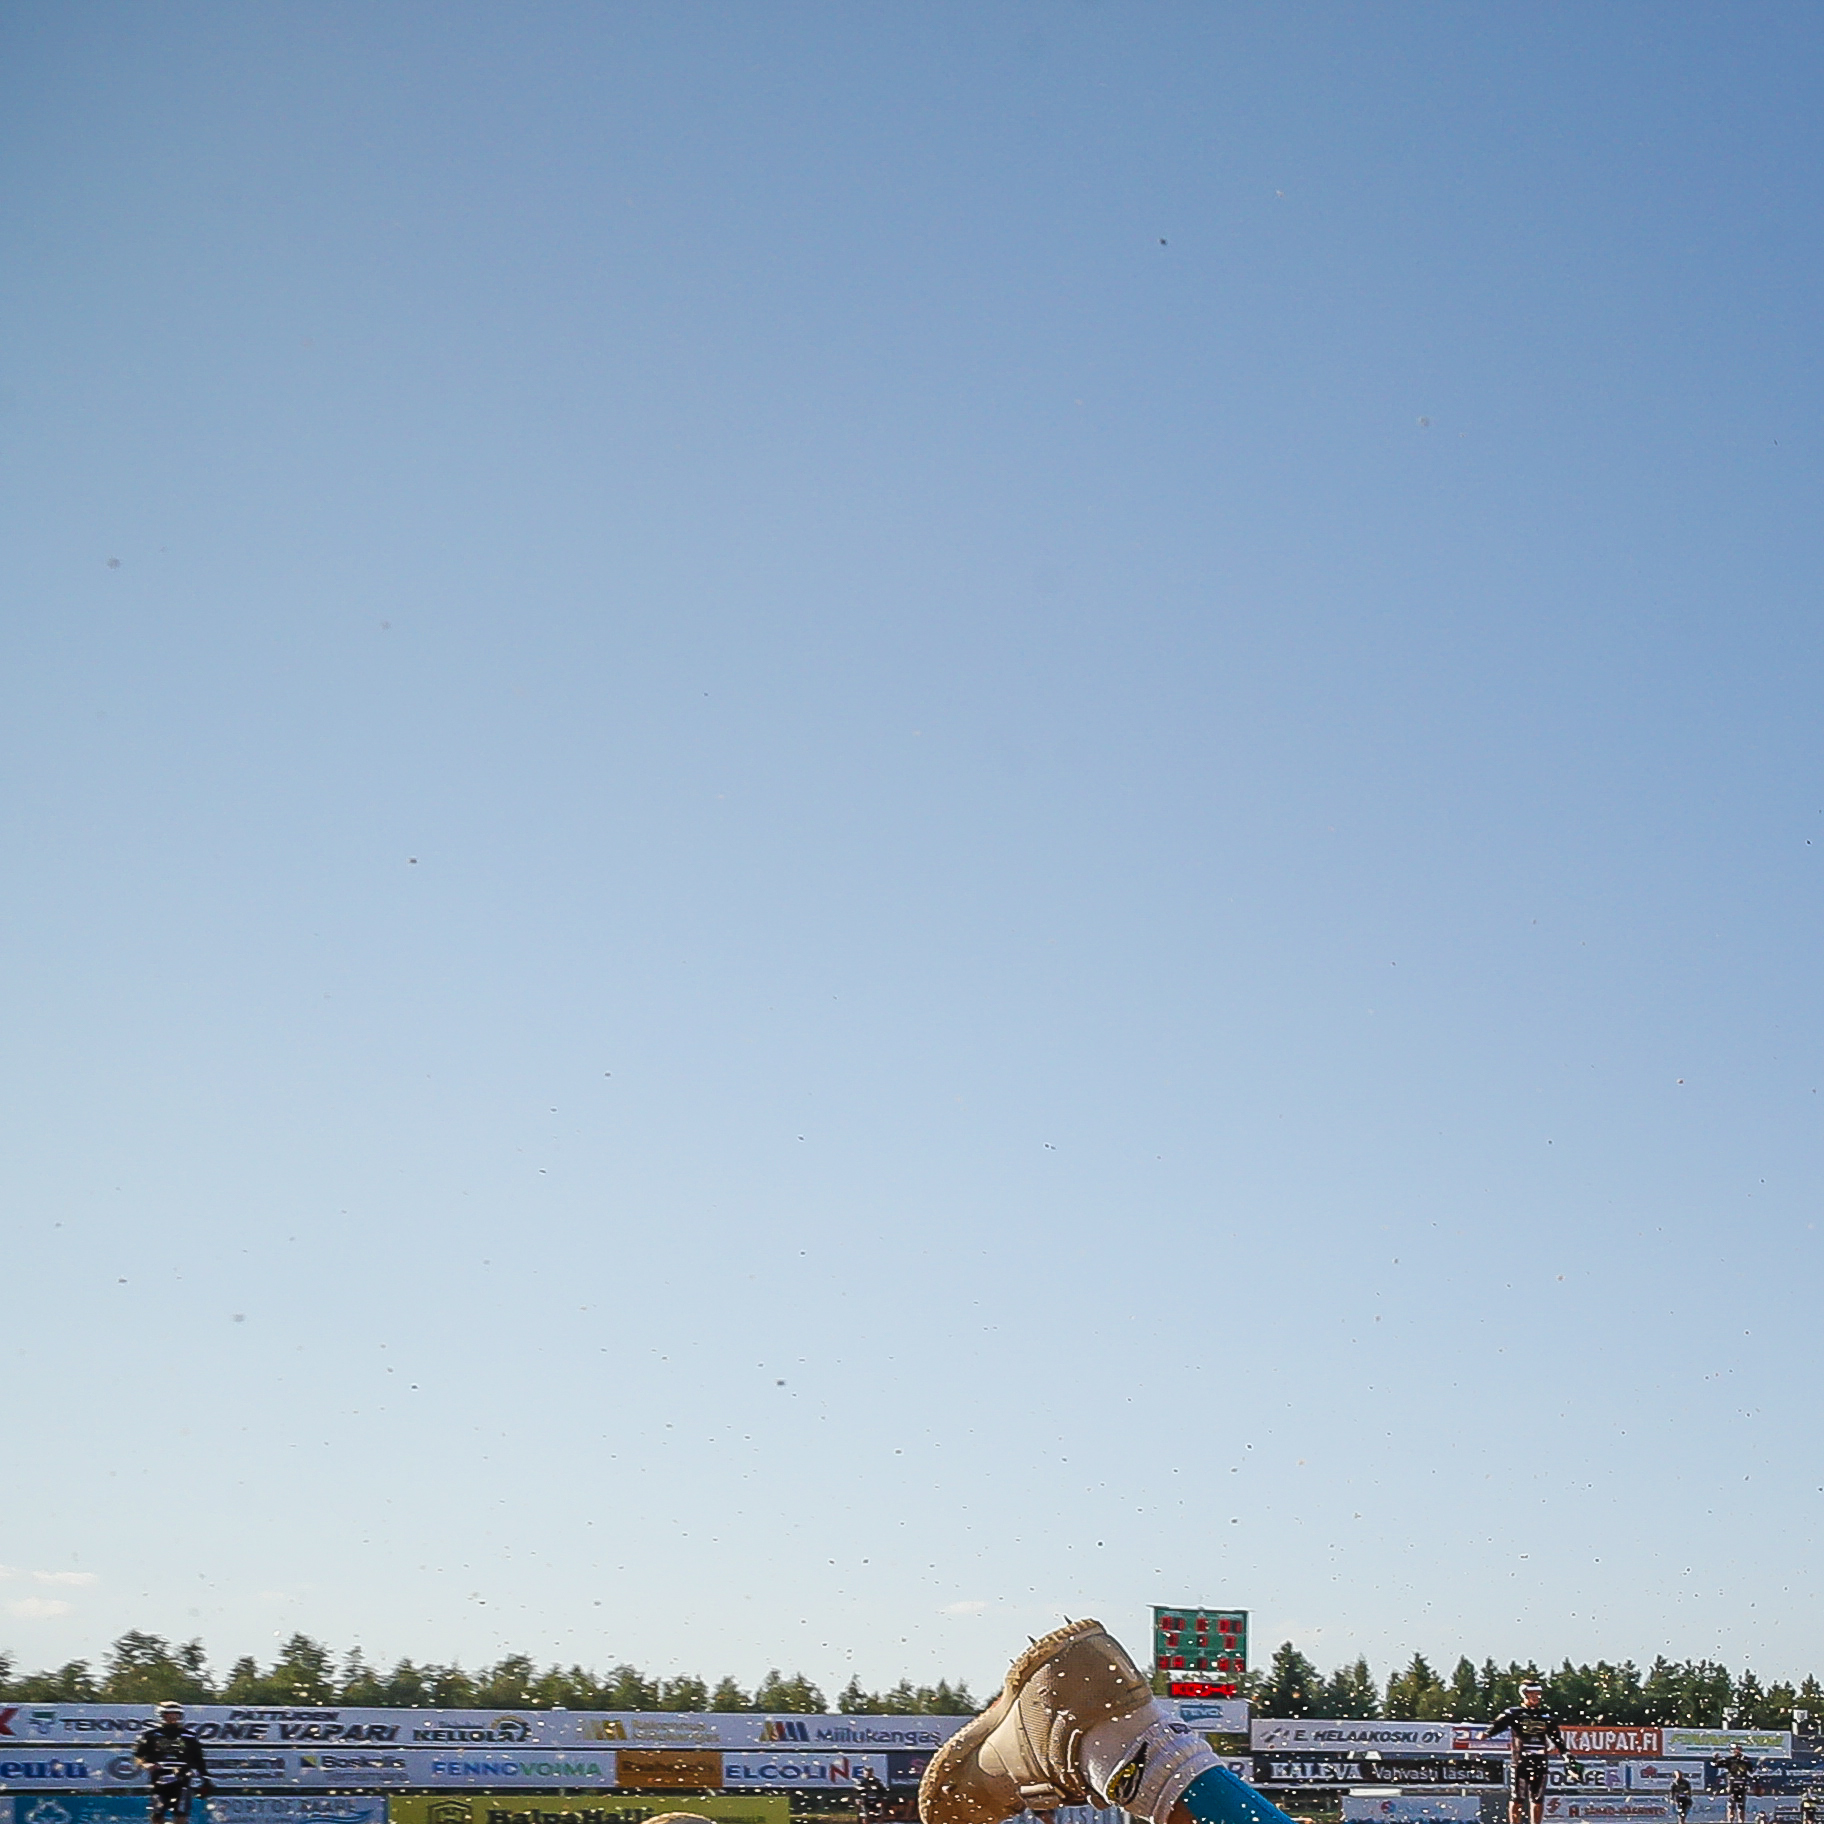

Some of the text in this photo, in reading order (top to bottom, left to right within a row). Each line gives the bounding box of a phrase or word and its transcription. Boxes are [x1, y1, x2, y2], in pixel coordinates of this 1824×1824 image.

[816, 1727, 941, 1746] Miilukangas
[1313, 1730, 1418, 1743] HELAAKOSKI
[1421, 1731, 1444, 1744] OY
[432, 1761, 601, 1776] FENNOVOIMA
[1270, 1762, 1364, 1780] KALEVA
